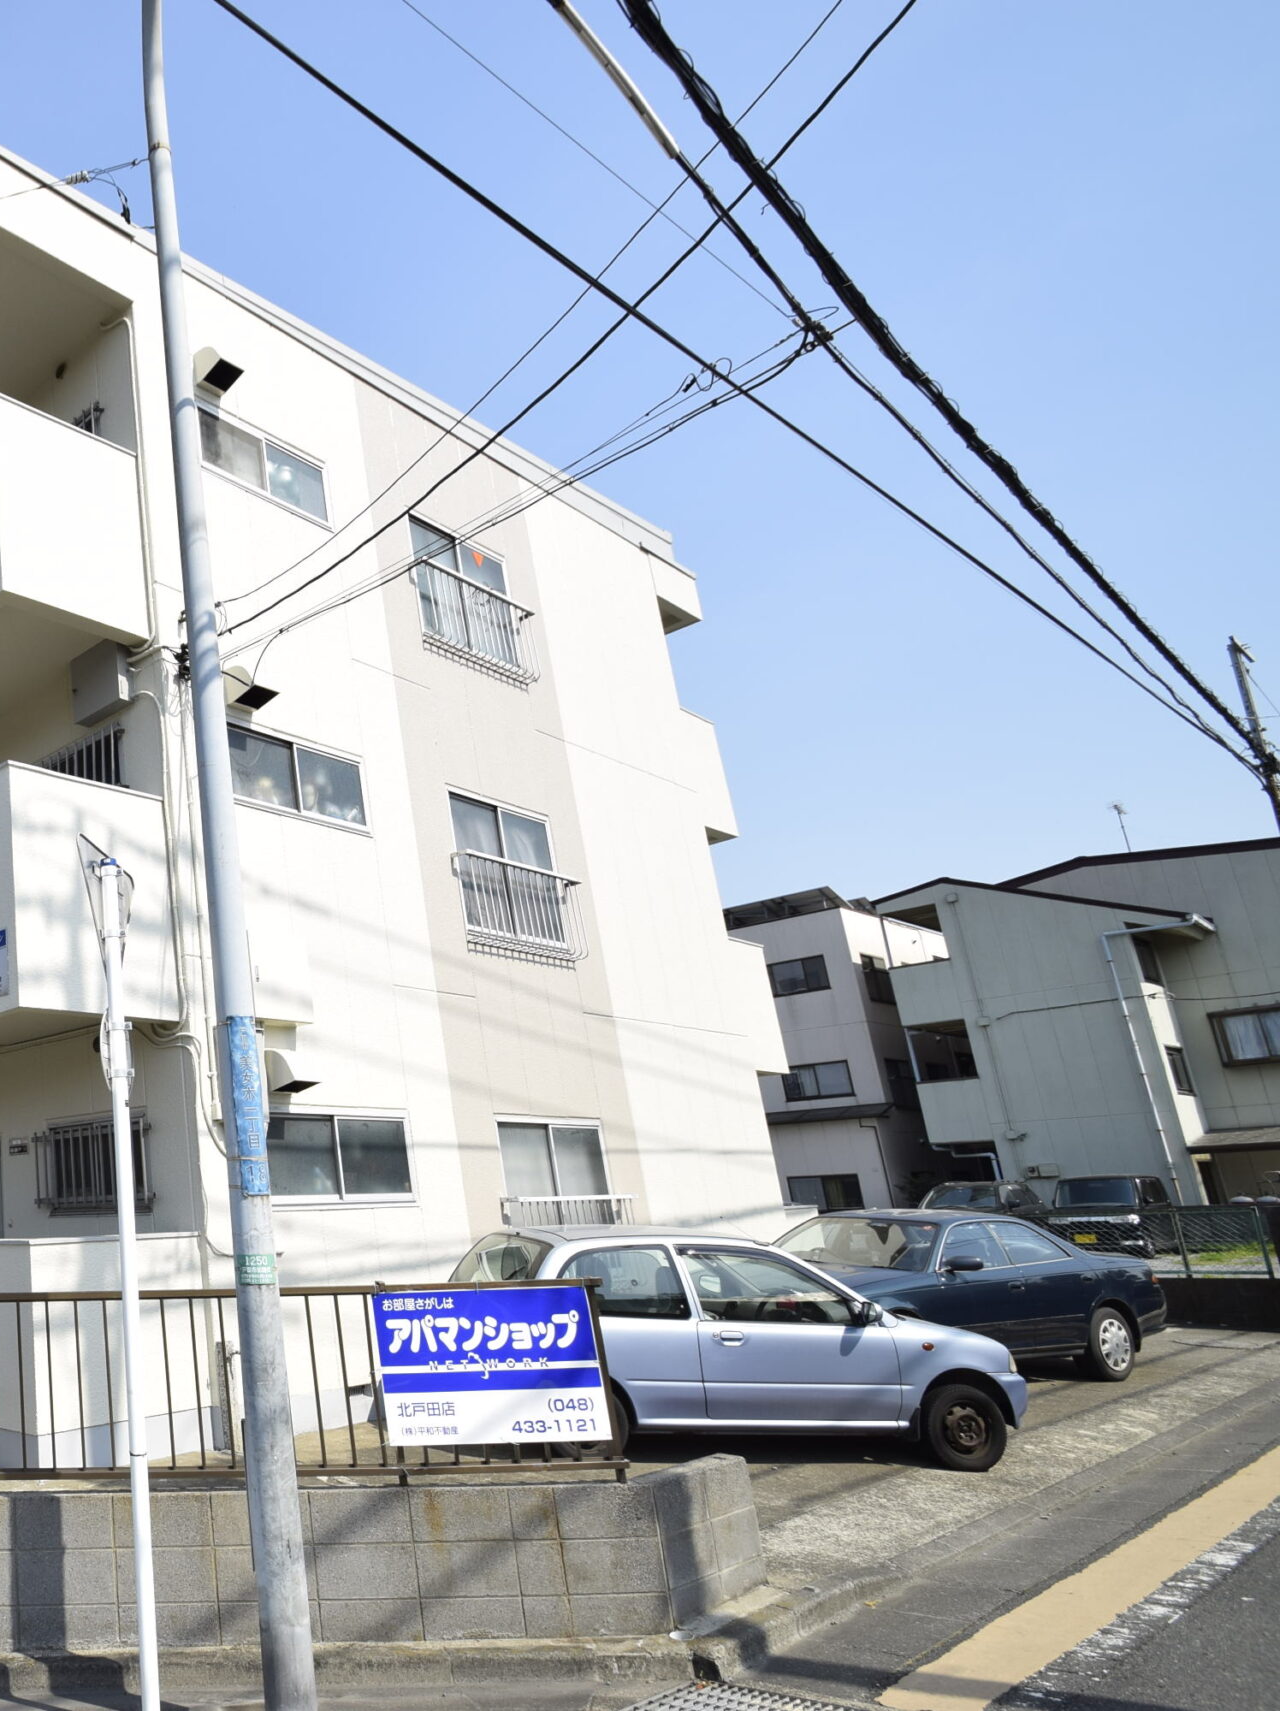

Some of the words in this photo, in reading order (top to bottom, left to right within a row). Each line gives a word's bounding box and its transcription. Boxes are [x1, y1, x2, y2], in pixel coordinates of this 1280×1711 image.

[245, 1255, 268, 1266] 1250
[382, 1297, 454, 1311] お部屋さがしは
[385, 1309, 580, 1354] アパマンショップ
[397, 1401, 456, 1418] 北戸田店
[547, 1397, 595, 1413] (048)
[512, 1418, 597, 1433] 433-1121
